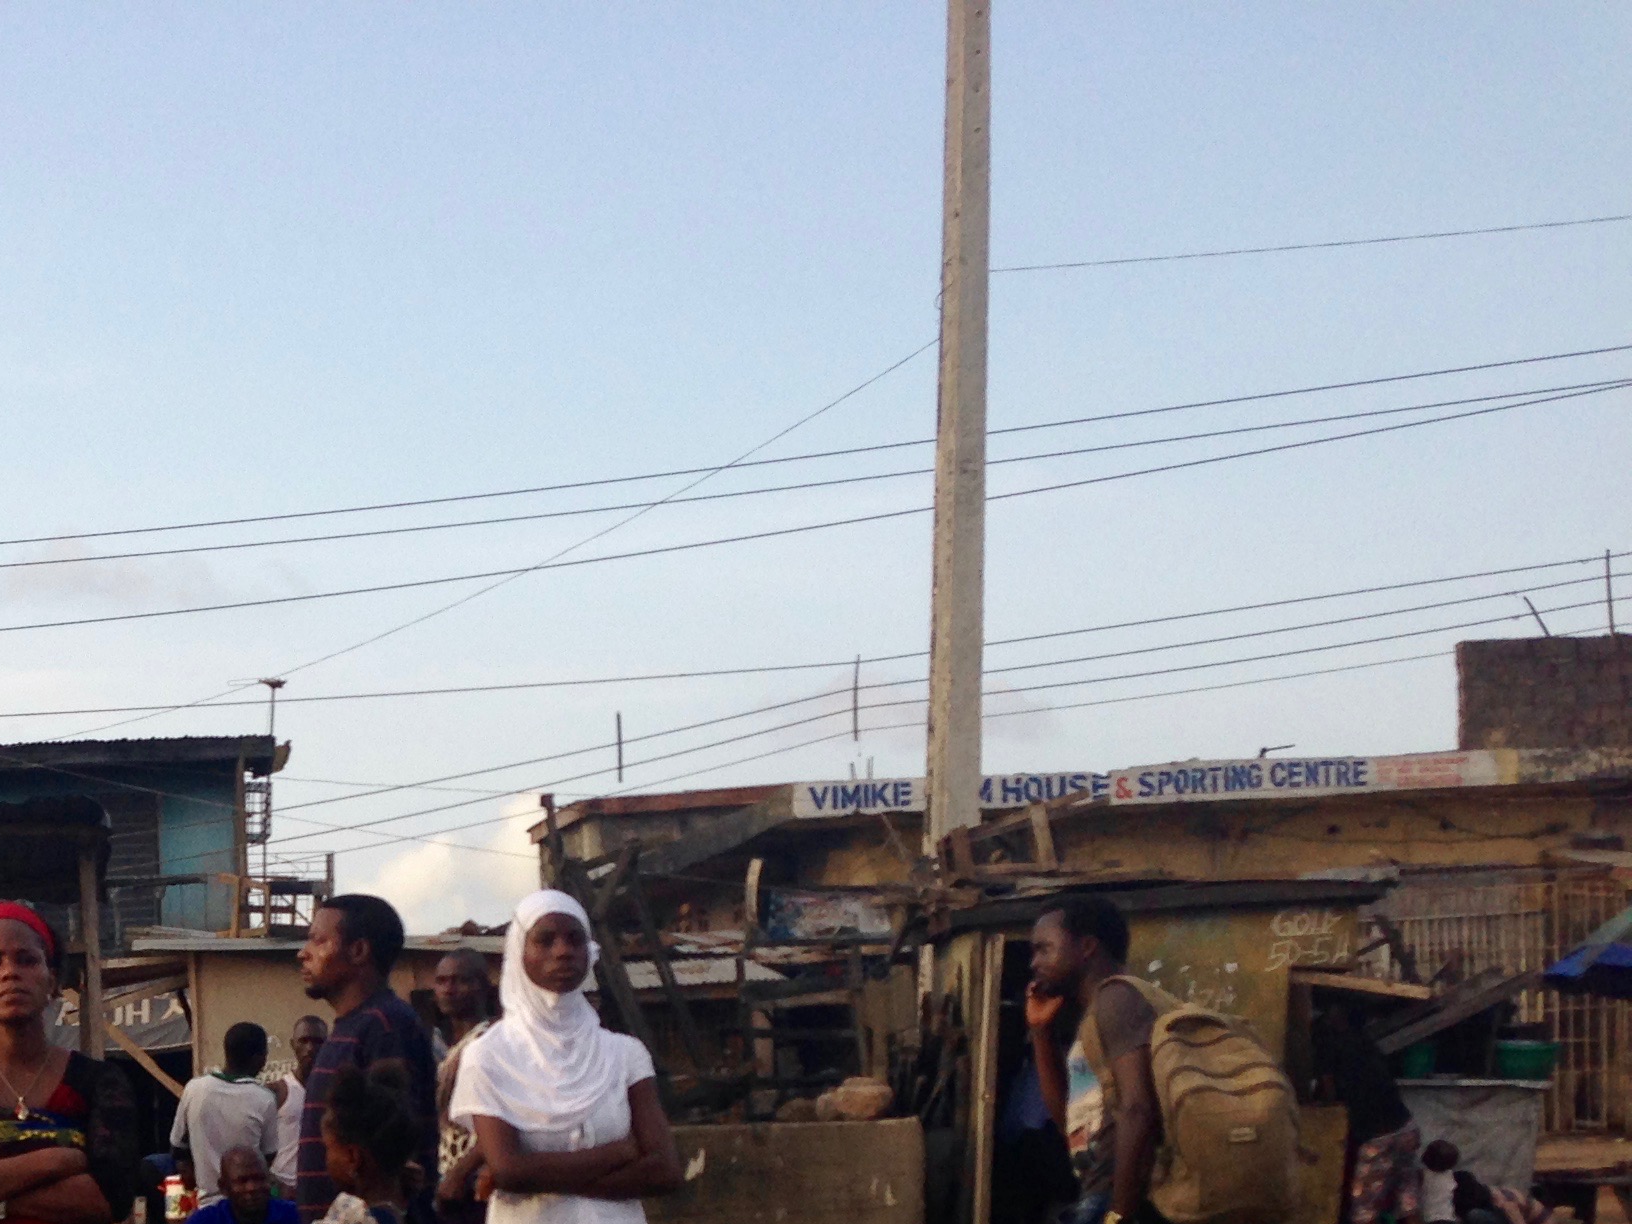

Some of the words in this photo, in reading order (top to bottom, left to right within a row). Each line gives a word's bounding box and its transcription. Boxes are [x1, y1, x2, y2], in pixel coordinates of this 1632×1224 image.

[808, 782, 912, 810] VIMIKE
[1001, 774, 1111, 803] HOUSE
[1115, 776, 1133, 799] &
[1138, 763, 1263, 797] SPORTING
[1269, 760, 1368, 788] CENTRE
